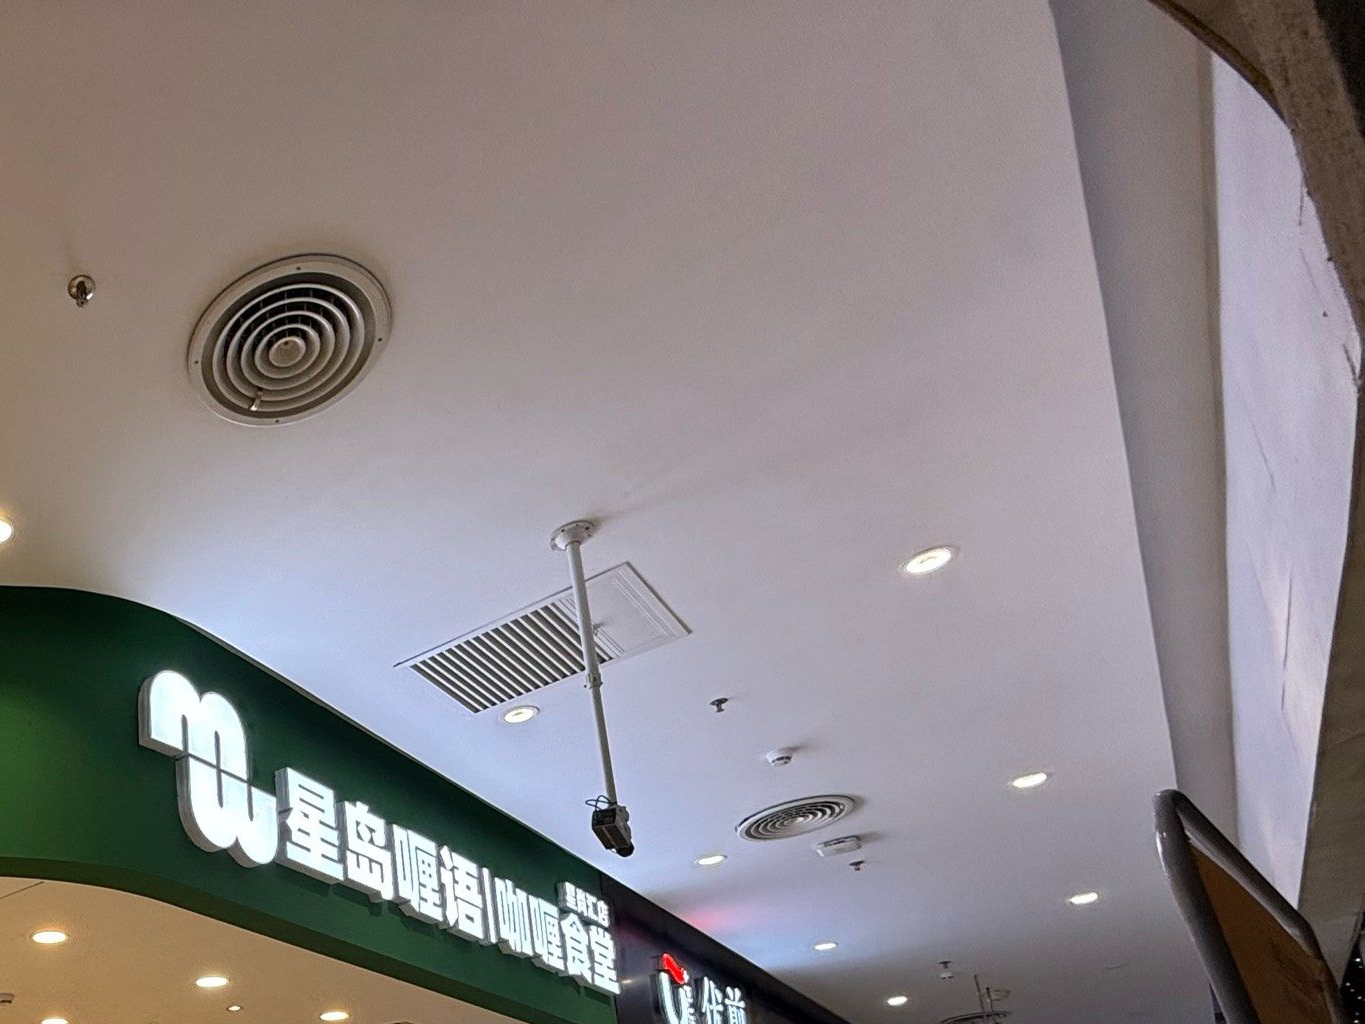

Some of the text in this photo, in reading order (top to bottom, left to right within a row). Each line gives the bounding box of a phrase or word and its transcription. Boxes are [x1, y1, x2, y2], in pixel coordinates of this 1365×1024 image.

[278, 768, 621, 995] 星岛喱语 咖喱食堂
